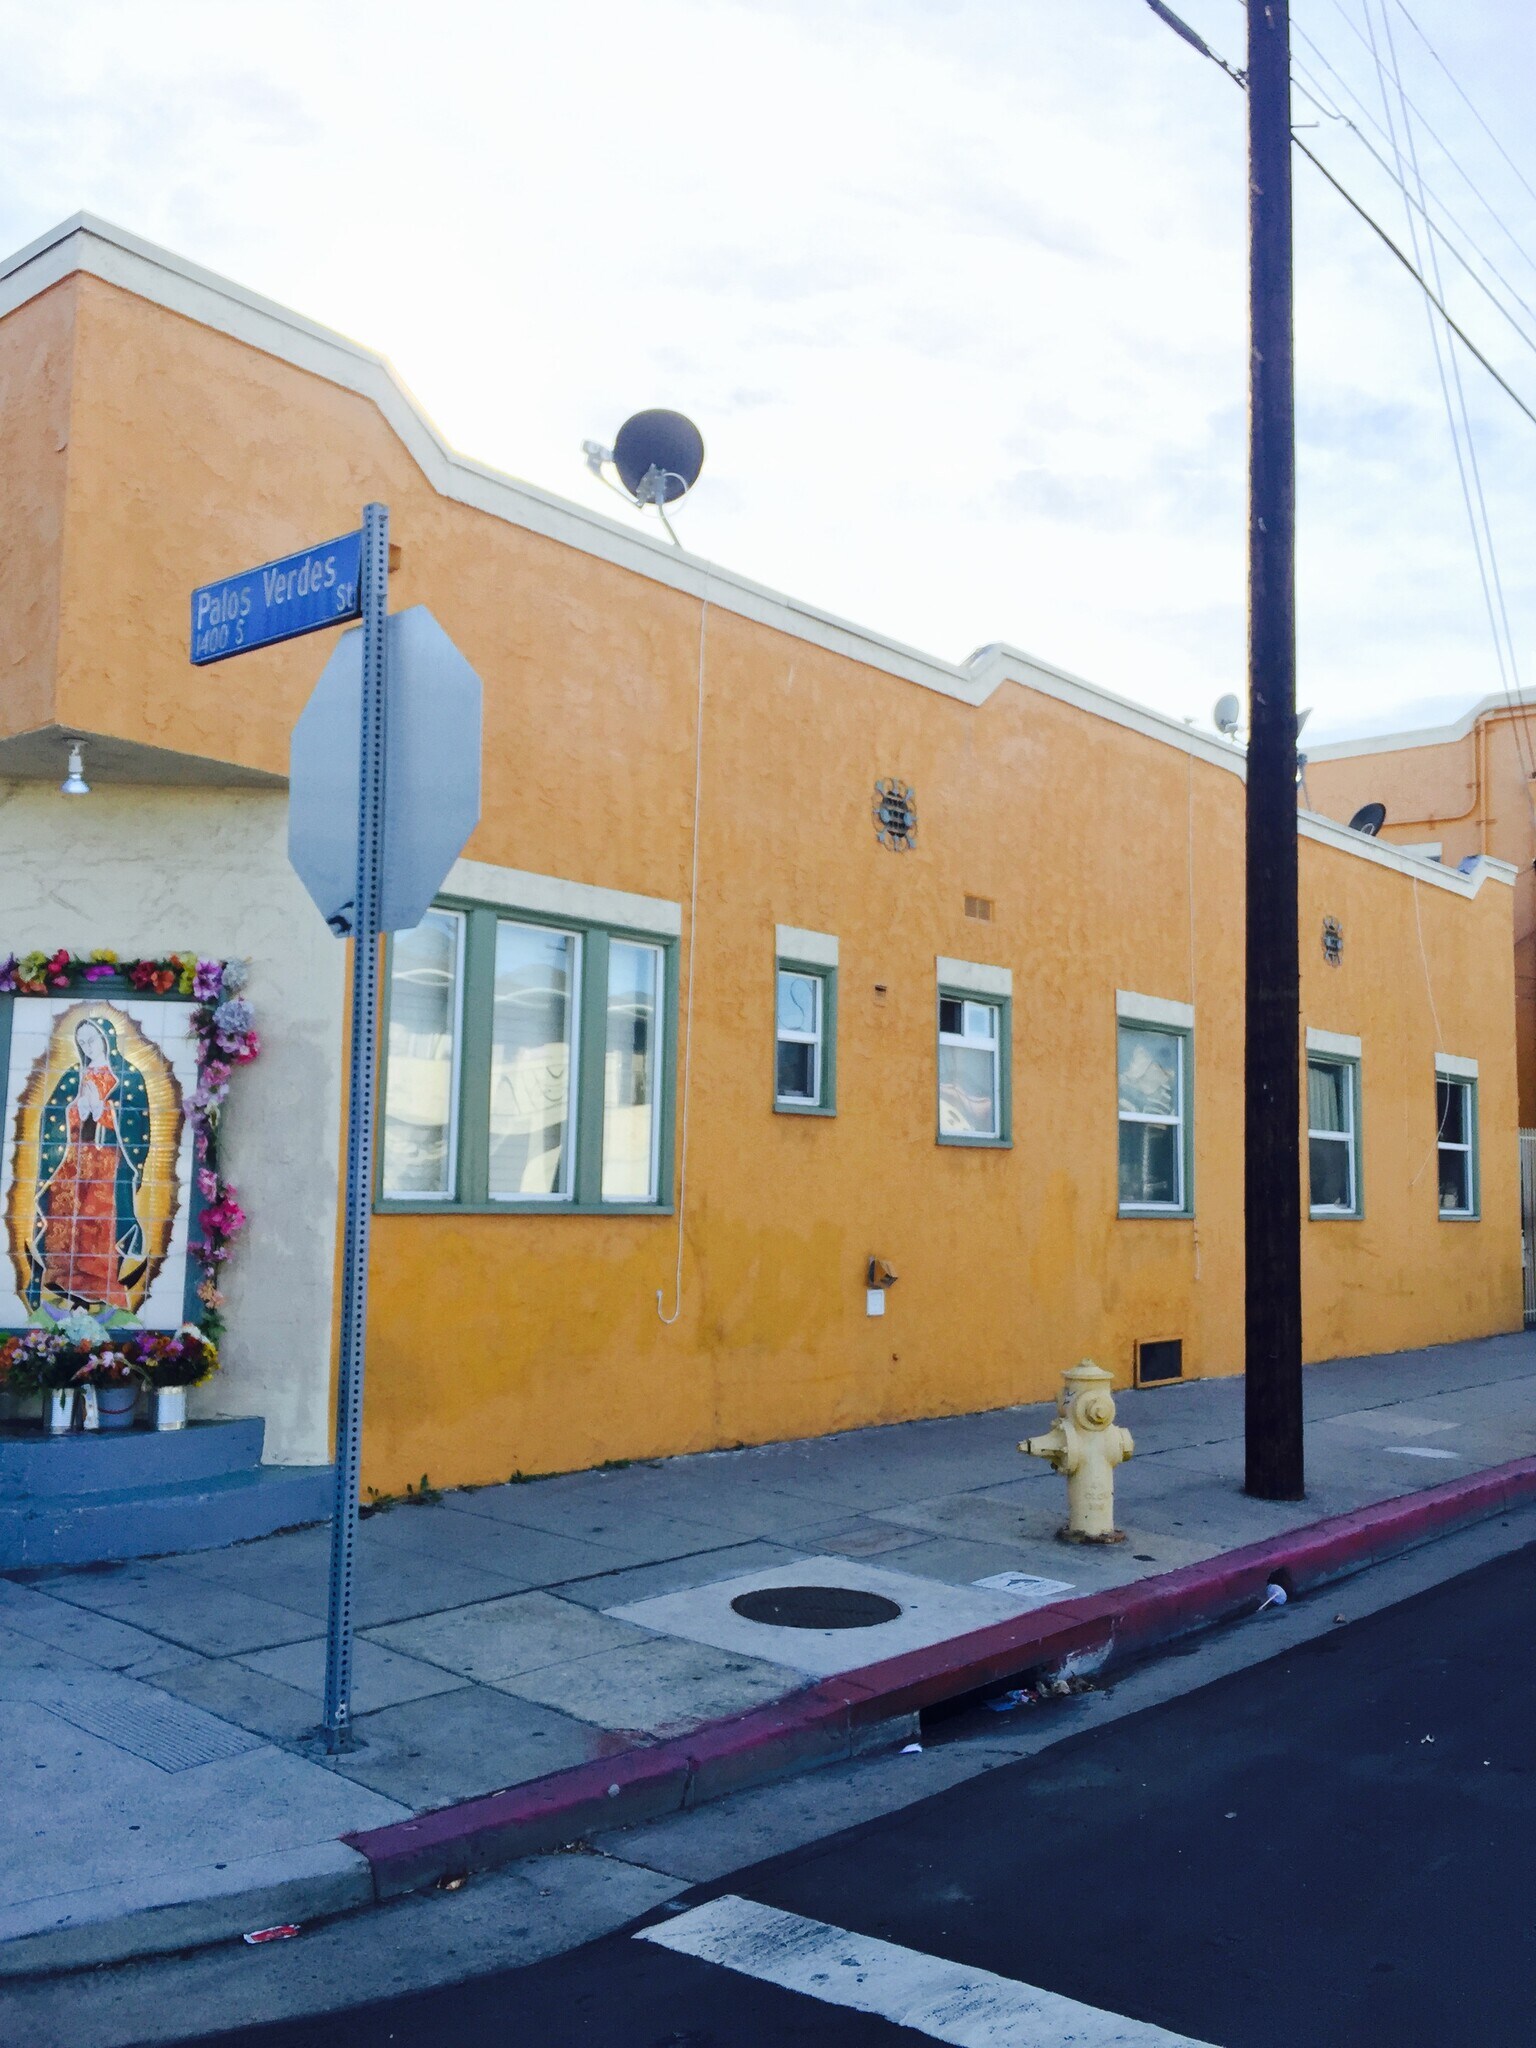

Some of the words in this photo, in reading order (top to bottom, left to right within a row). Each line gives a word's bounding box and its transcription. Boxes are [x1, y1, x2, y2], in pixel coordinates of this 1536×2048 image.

[197, 586, 251, 630] Palos
[263, 556, 336, 608] Verdes
[337, 583, 354, 612] St
[196, 623, 229, 656] 1400
[235, 618, 245, 645] S
